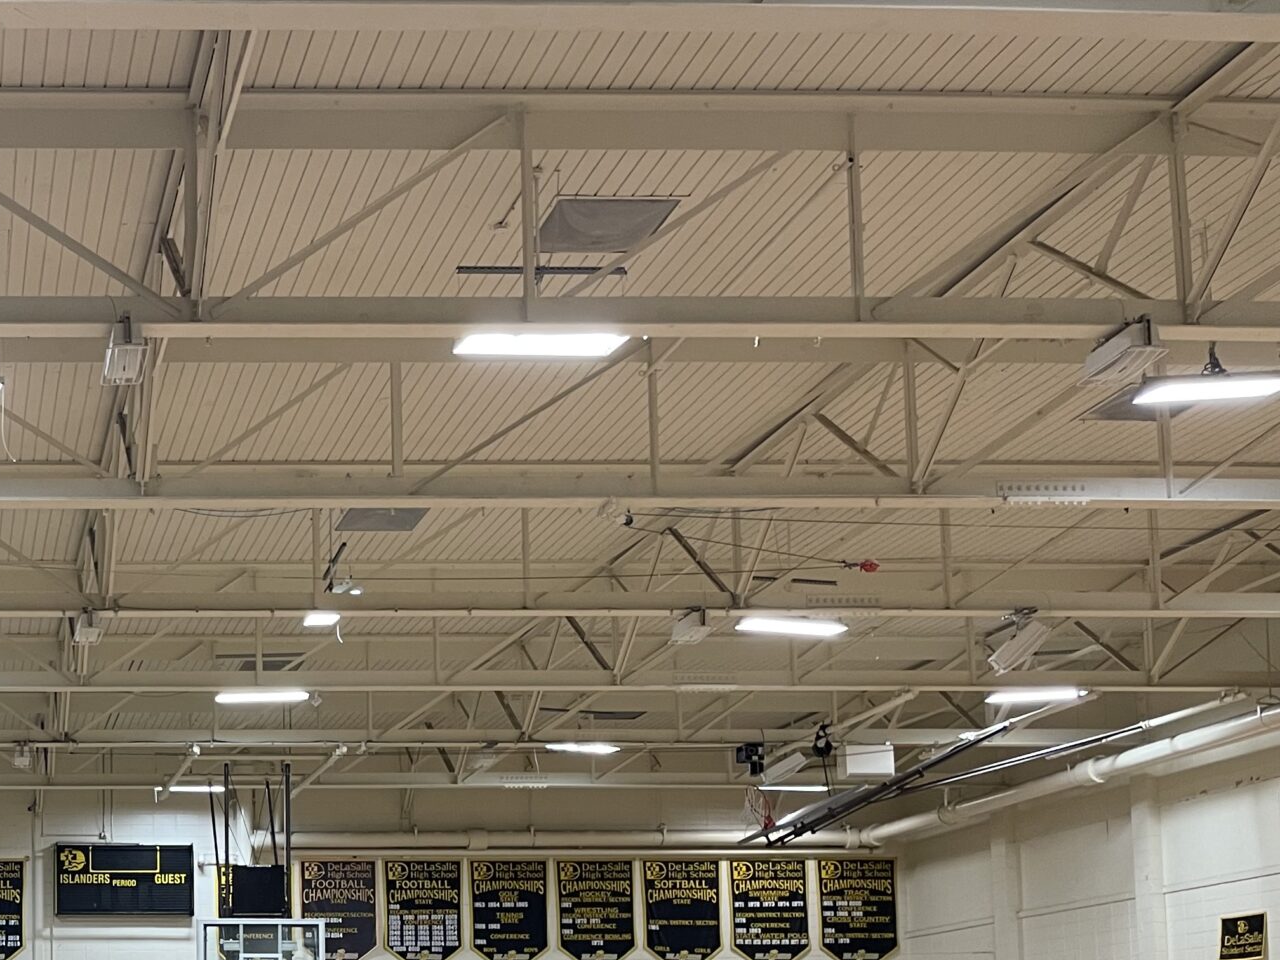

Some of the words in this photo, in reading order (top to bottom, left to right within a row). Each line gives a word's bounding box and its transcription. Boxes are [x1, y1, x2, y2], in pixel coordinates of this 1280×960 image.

[327, 863, 372, 871] DeLaSalle
[410, 863, 458, 871] DeLaSalle
[496, 863, 544, 871] DeLaSalle
[582, 863, 630, 871] DeLaSalle
[668, 863, 716, 871] DeLaSalle
[755, 862, 803, 871] DeLaSalle
[843, 862, 891, 870] DeLaSalle
[60, 874, 110, 884] ISLANDERS
[155, 874, 187, 884] GUEST
[327, 872, 344, 880] High
[410, 872, 429, 880] High
[496, 872, 514, 880] High
[582, 872, 601, 880] High
[668, 872, 687, 880] High
[755, 871, 775, 879] High
[843, 871, 862, 879] High
[311, 880, 366, 888] FOOTBALL
[396, 880, 451, 888] FOOTBALL
[474, 880, 544, 894] CHAMPIONSHIPS
[560, 880, 631, 895] CHAMPIONSHIPS
[655, 880, 708, 888] SOFTBALL
[733, 880, 804, 894] CHAMPIONSHIPS
[822, 879, 892, 894] CHAMPIONSHIPS
[303, 889, 374, 903] CHAMPIONSHIPS
[389, 889, 459, 903] CHAMPIONSHIPS
[648, 889, 717, 904] CHAMPIONSHIPS
[1225, 932, 1263, 946] DeLaSalle
